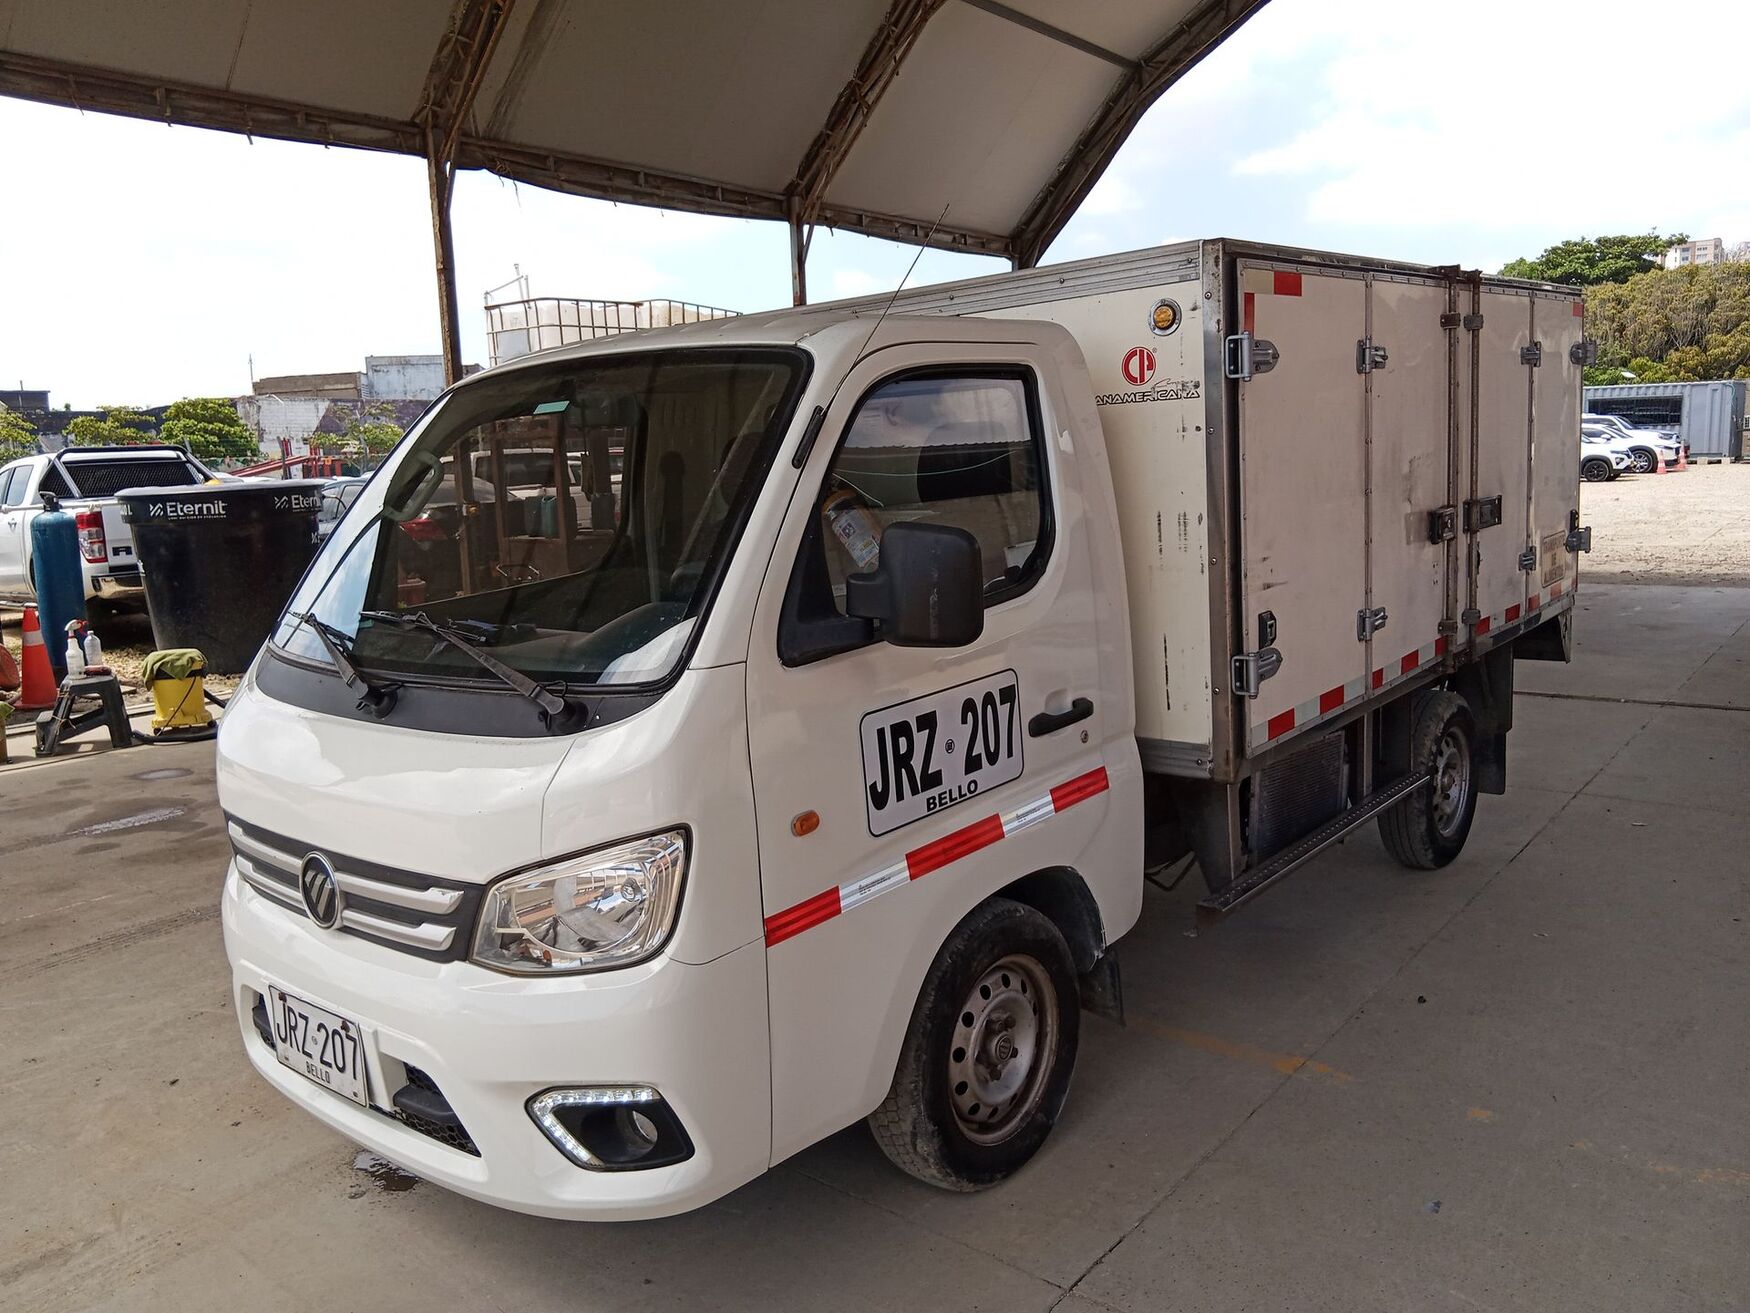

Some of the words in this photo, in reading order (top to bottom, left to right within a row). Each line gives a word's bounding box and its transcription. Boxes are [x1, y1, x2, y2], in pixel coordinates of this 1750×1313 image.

[166, 500, 228, 516] Eternit
[868, 710, 943, 811] JRZ
[960, 683, 1017, 776] 207
[926, 779, 979, 813] BELLO
[276, 1001, 313, 1059] JRZ
[317, 1022, 359, 1081] 207
[306, 1060, 330, 1083] BELLO
